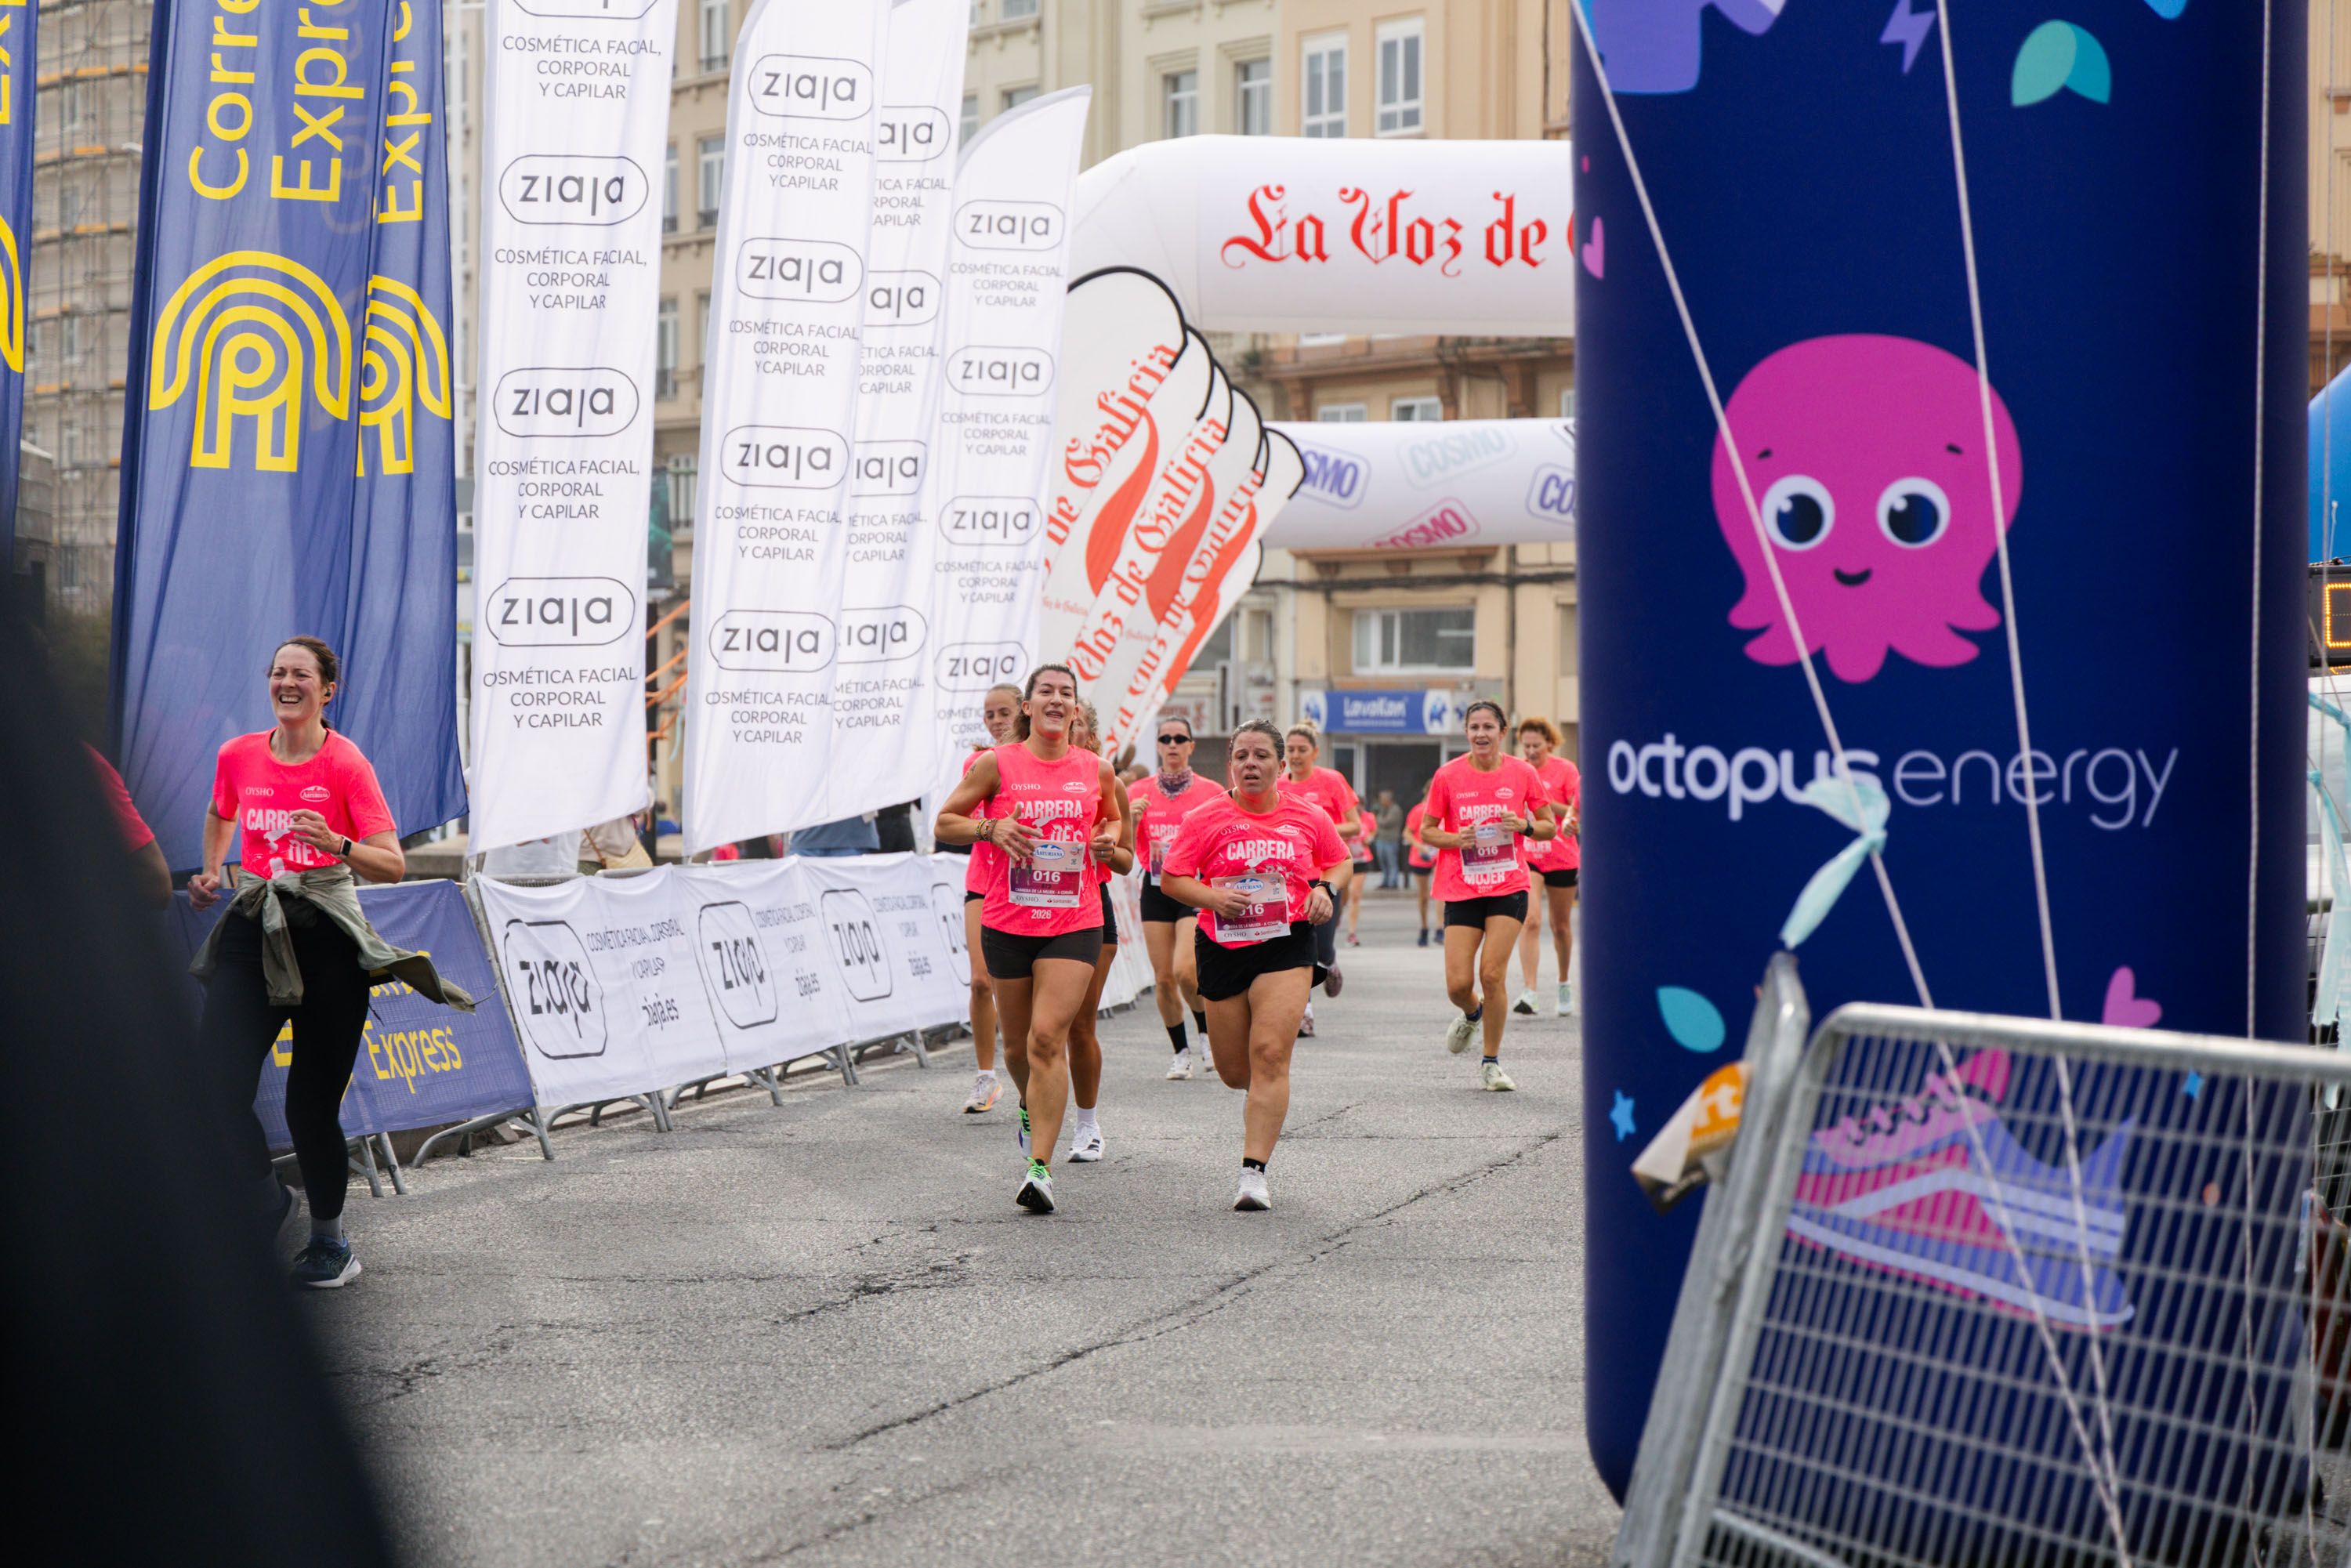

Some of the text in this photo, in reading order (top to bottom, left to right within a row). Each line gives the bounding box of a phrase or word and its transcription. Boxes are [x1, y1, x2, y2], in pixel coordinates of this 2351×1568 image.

[502, 34, 602, 54] COSMÉTICA
[537, 60, 631, 77] CORPORAL
[539, 82, 626, 100] Y CAPILAR
[762, 71, 857, 110] ziaja
[744, 132, 819, 150] COSMÉTICA
[767, 154, 843, 172] CORPORAL
[519, 176, 625, 216] ziaja
[969, 214, 1049, 244] ziaja
[1220, 184, 1331, 269] La
[1339, 187, 1463, 277] Voz
[1485, 191, 1549, 268] de
[495, 246, 647, 266] COSMÉTICA FACIAL,
[527, 272, 610, 288] CORPORAL
[748, 255, 843, 293] ziaja
[973, 280, 1039, 292] CORPORAL
[529, 295, 606, 310] Y CAPILAR
[974, 295, 1036, 306] Y CAPILAR
[729, 319, 804, 337] COSMÉTICA
[753, 341, 829, 357] CORPORAL
[962, 360, 1040, 389] ziaja
[512, 388, 614, 428] ziaja
[964, 429, 1029, 440] CORPORAL
[965, 444, 1027, 455] Y CAPILAR
[488, 456, 640, 476] COSMÉTICA FACIAL,
[737, 444, 831, 480] ziaja
[518, 482, 603, 497] CORPORAL
[1539, 473, 1577, 515] CO
[518, 504, 600, 519] Y CAPILAR
[715, 504, 793, 520] COSMÉTICA
[953, 511, 1030, 539] ziaja
[1375, 508, 1467, 548] SMO
[737, 527, 818, 542] CORPORAL
[739, 546, 814, 561] Y CAPILAR
[958, 577, 1018, 588] CORPORAL
[501, 597, 612, 636] ziaja
[723, 628, 819, 663] ziaja
[839, 621, 907, 654] iaja
[948, 656, 1016, 683] ziaja
[510, 691, 606, 707] CORPORAL
[513, 712, 603, 728] Y CAPILAR
[731, 711, 806, 725] CORPORAL
[846, 715, 900, 728] CAPILAR
[744, 730, 802, 744] CAPILAR
[245, 787, 274, 797] OYSHO
[1893, 748, 2179, 829] energy
[1220, 823, 1250, 835] OYSHO
[1478, 846, 1498, 856] 016
[1033, 870, 1061, 882] 016
[362, 1020, 462, 1094] Express
